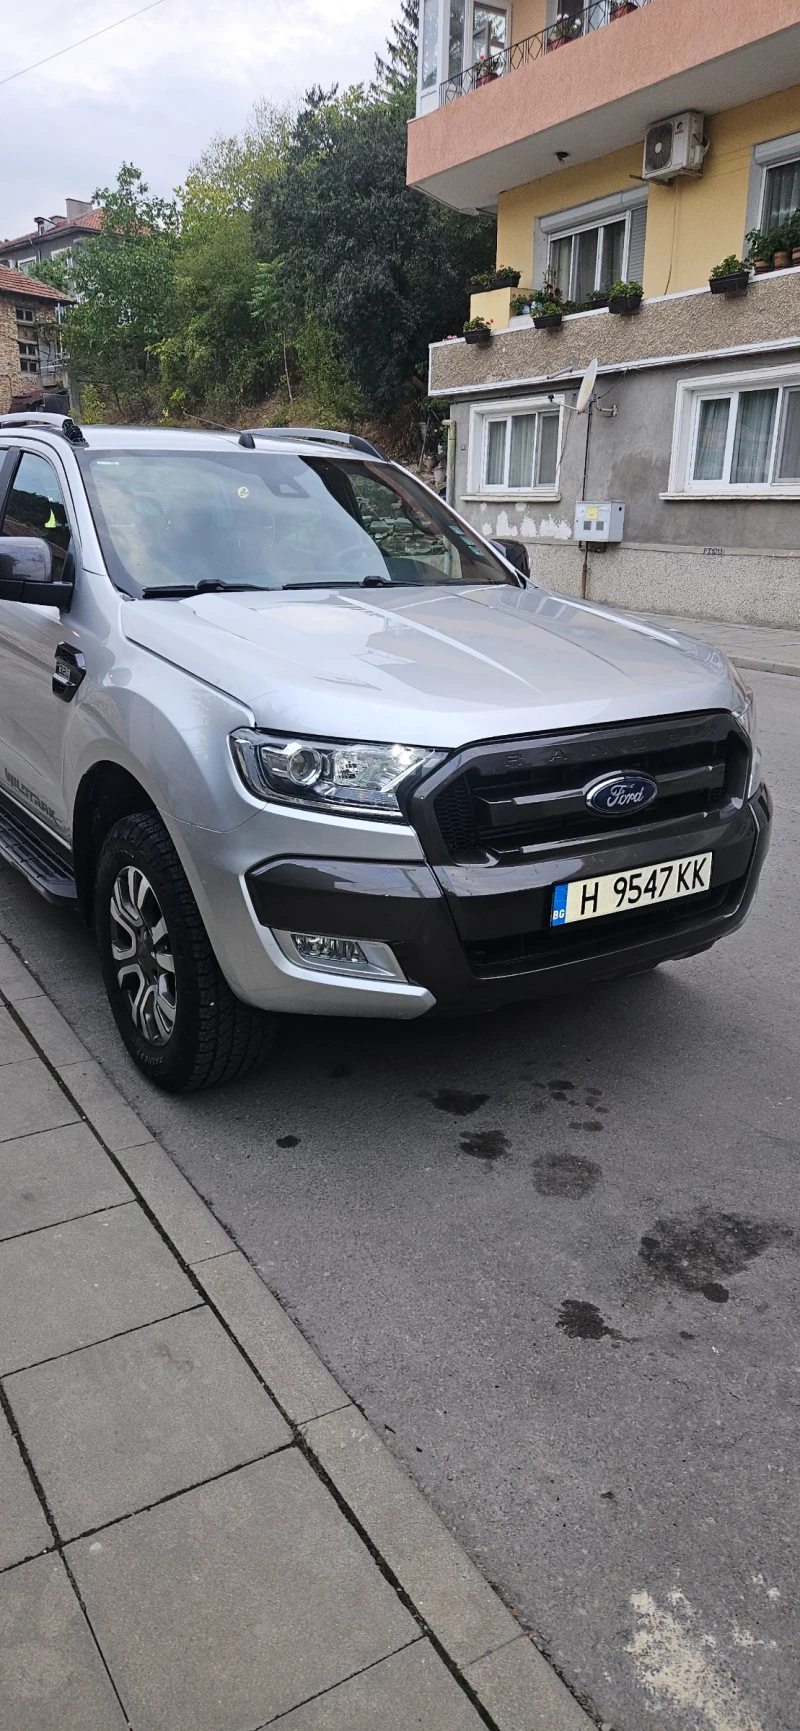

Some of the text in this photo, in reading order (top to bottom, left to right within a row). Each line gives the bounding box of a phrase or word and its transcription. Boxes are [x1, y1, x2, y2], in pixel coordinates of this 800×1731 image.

[606, 783, 645, 808] Ford
[580, 881, 599, 916] H
[552, 909, 566, 920] BG
